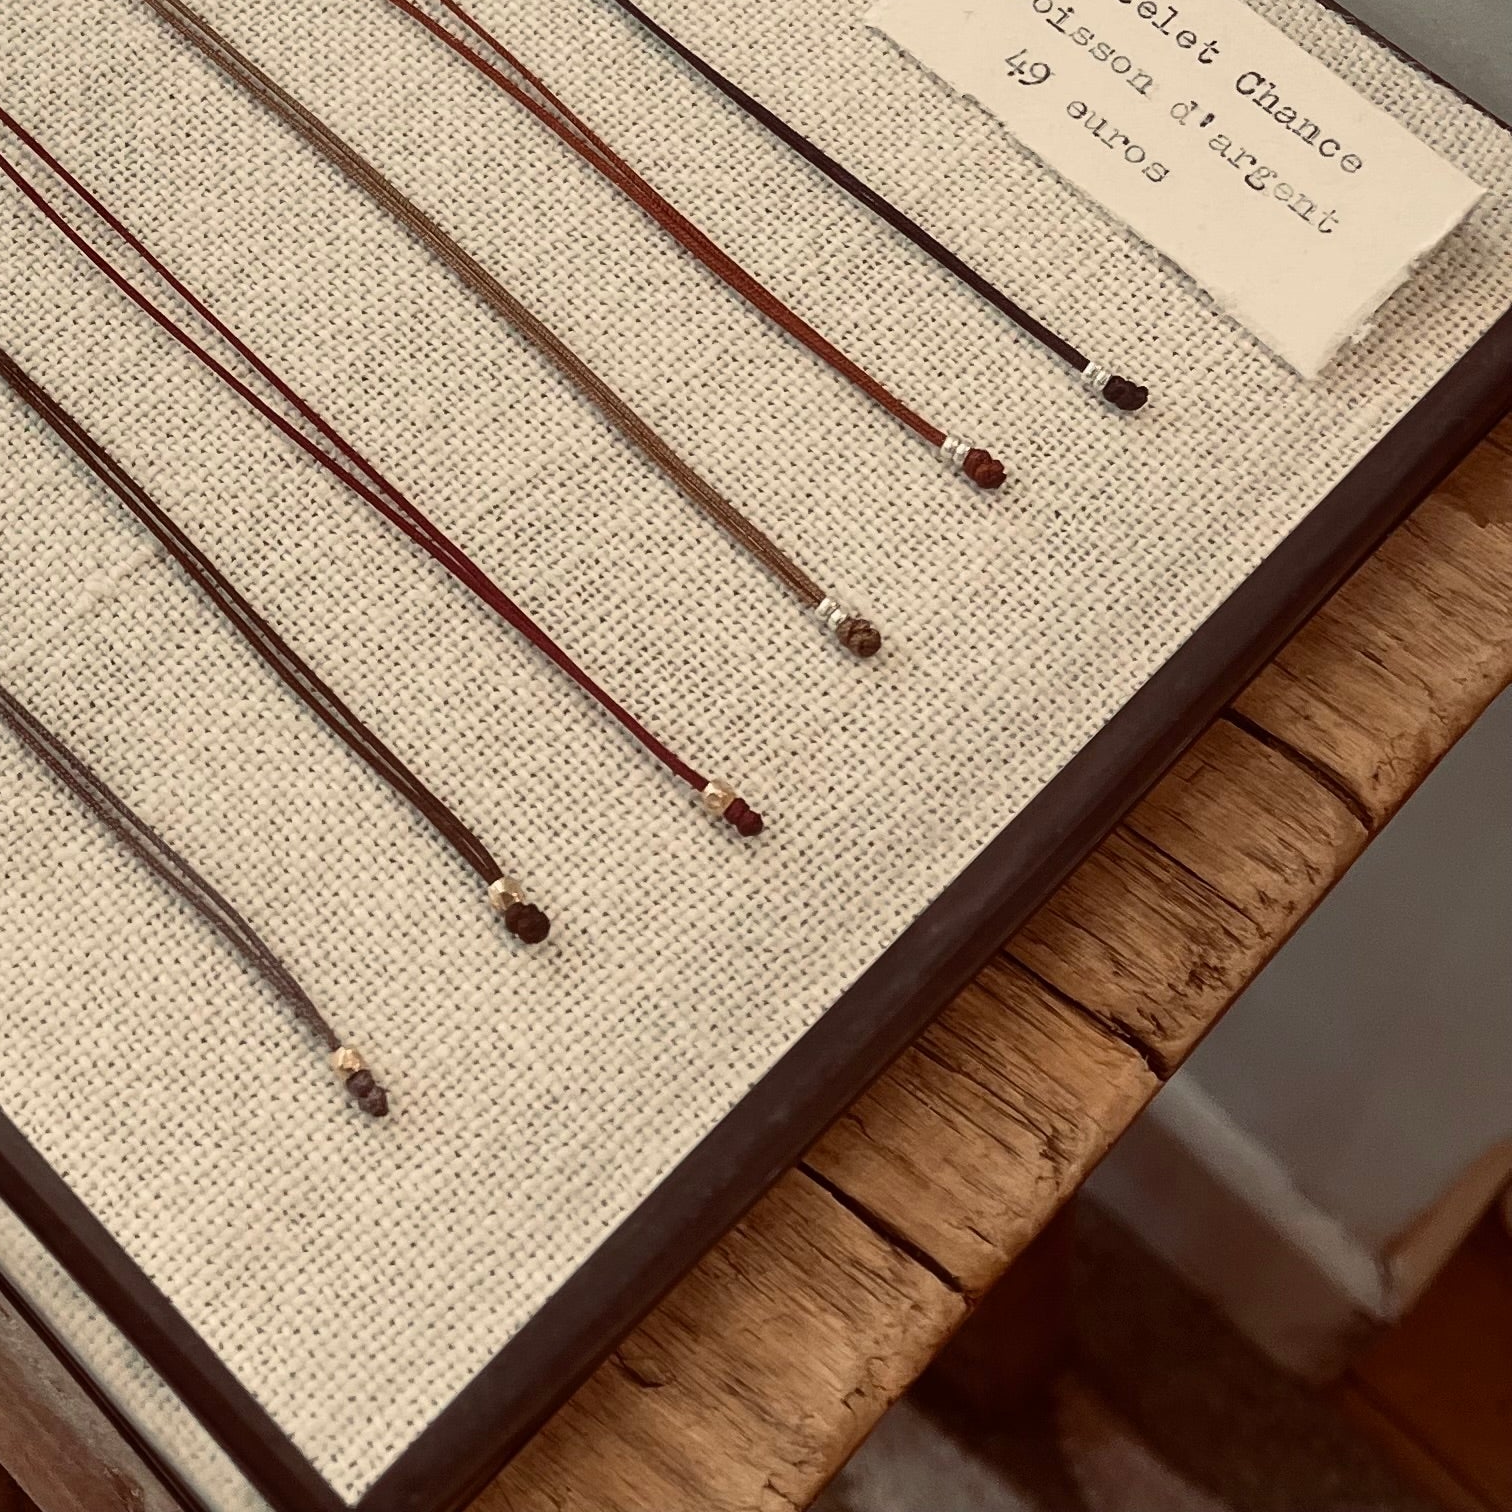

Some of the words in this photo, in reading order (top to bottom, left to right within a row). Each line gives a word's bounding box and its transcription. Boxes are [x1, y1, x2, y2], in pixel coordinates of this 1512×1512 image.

[1004, 48, 1051, 87] 49
[1066, 100, 1170, 184] euros
[1169, 100, 1337, 235] d'argent
[1235, 71, 1363, 174] Chance
